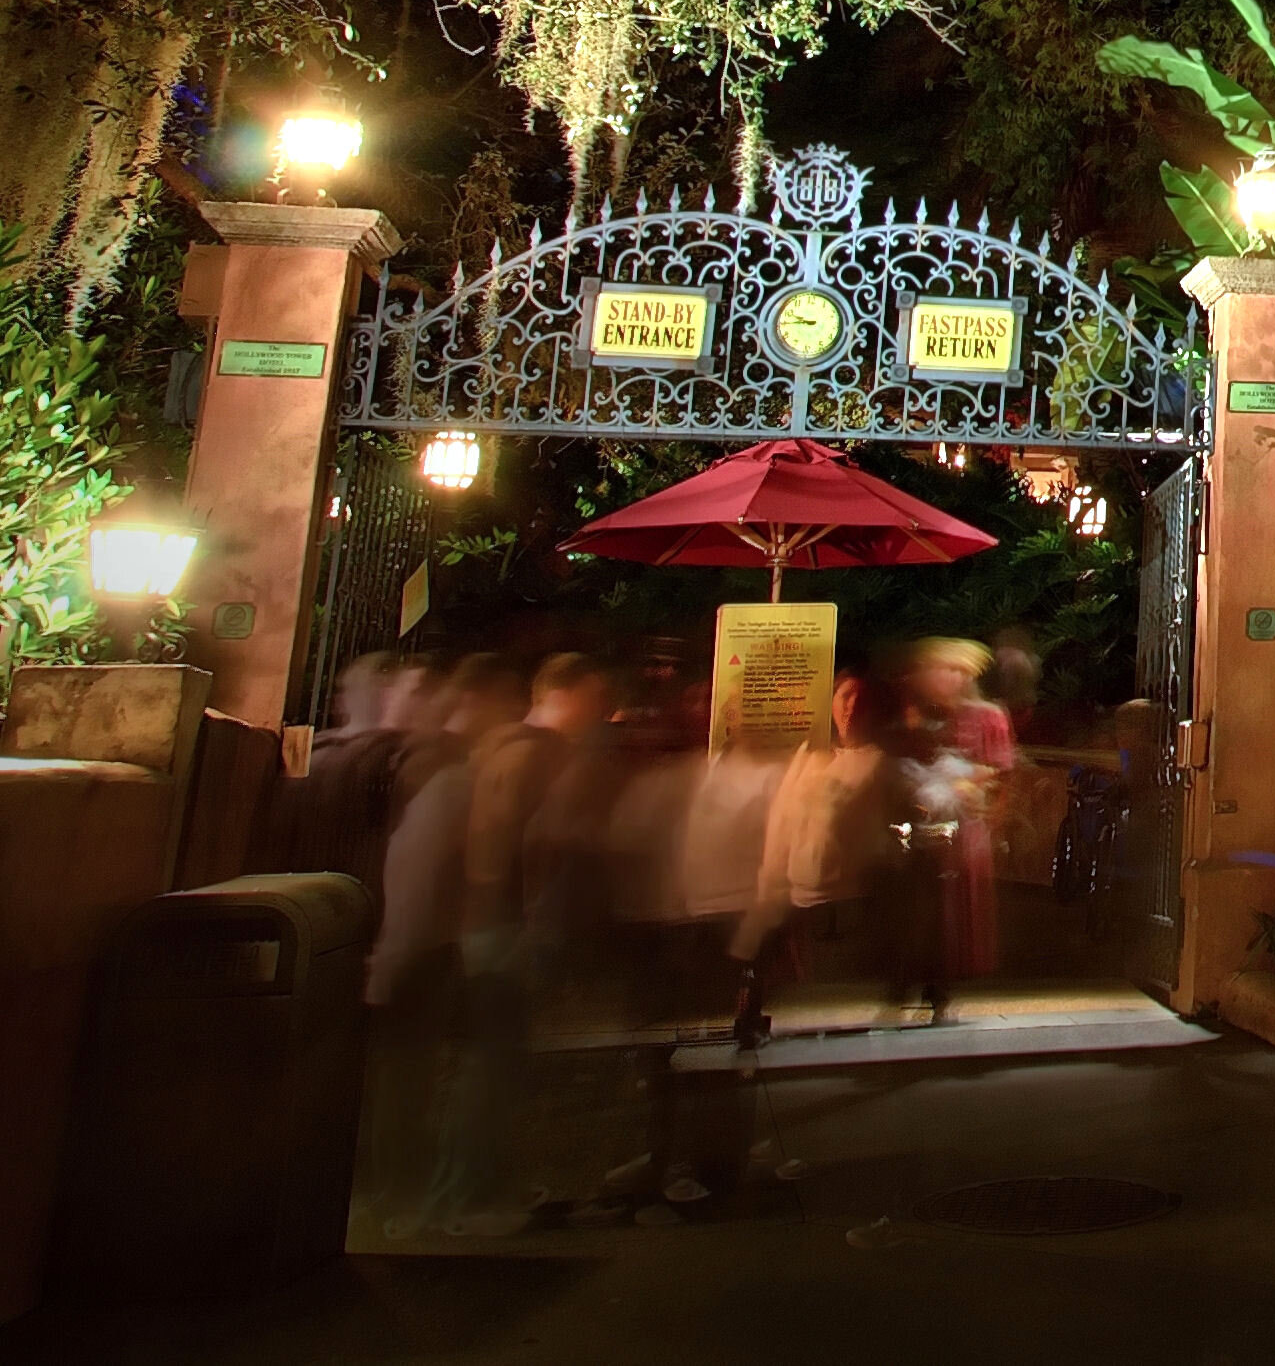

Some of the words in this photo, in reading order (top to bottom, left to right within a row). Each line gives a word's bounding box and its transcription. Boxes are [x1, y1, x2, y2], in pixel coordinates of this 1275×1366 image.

[608, 299, 697, 325] STAND-BY
[603, 323, 696, 349] ENTRANCE
[919, 314, 1008, 338] FASTPASS
[926, 336, 997, 359] RETURN
